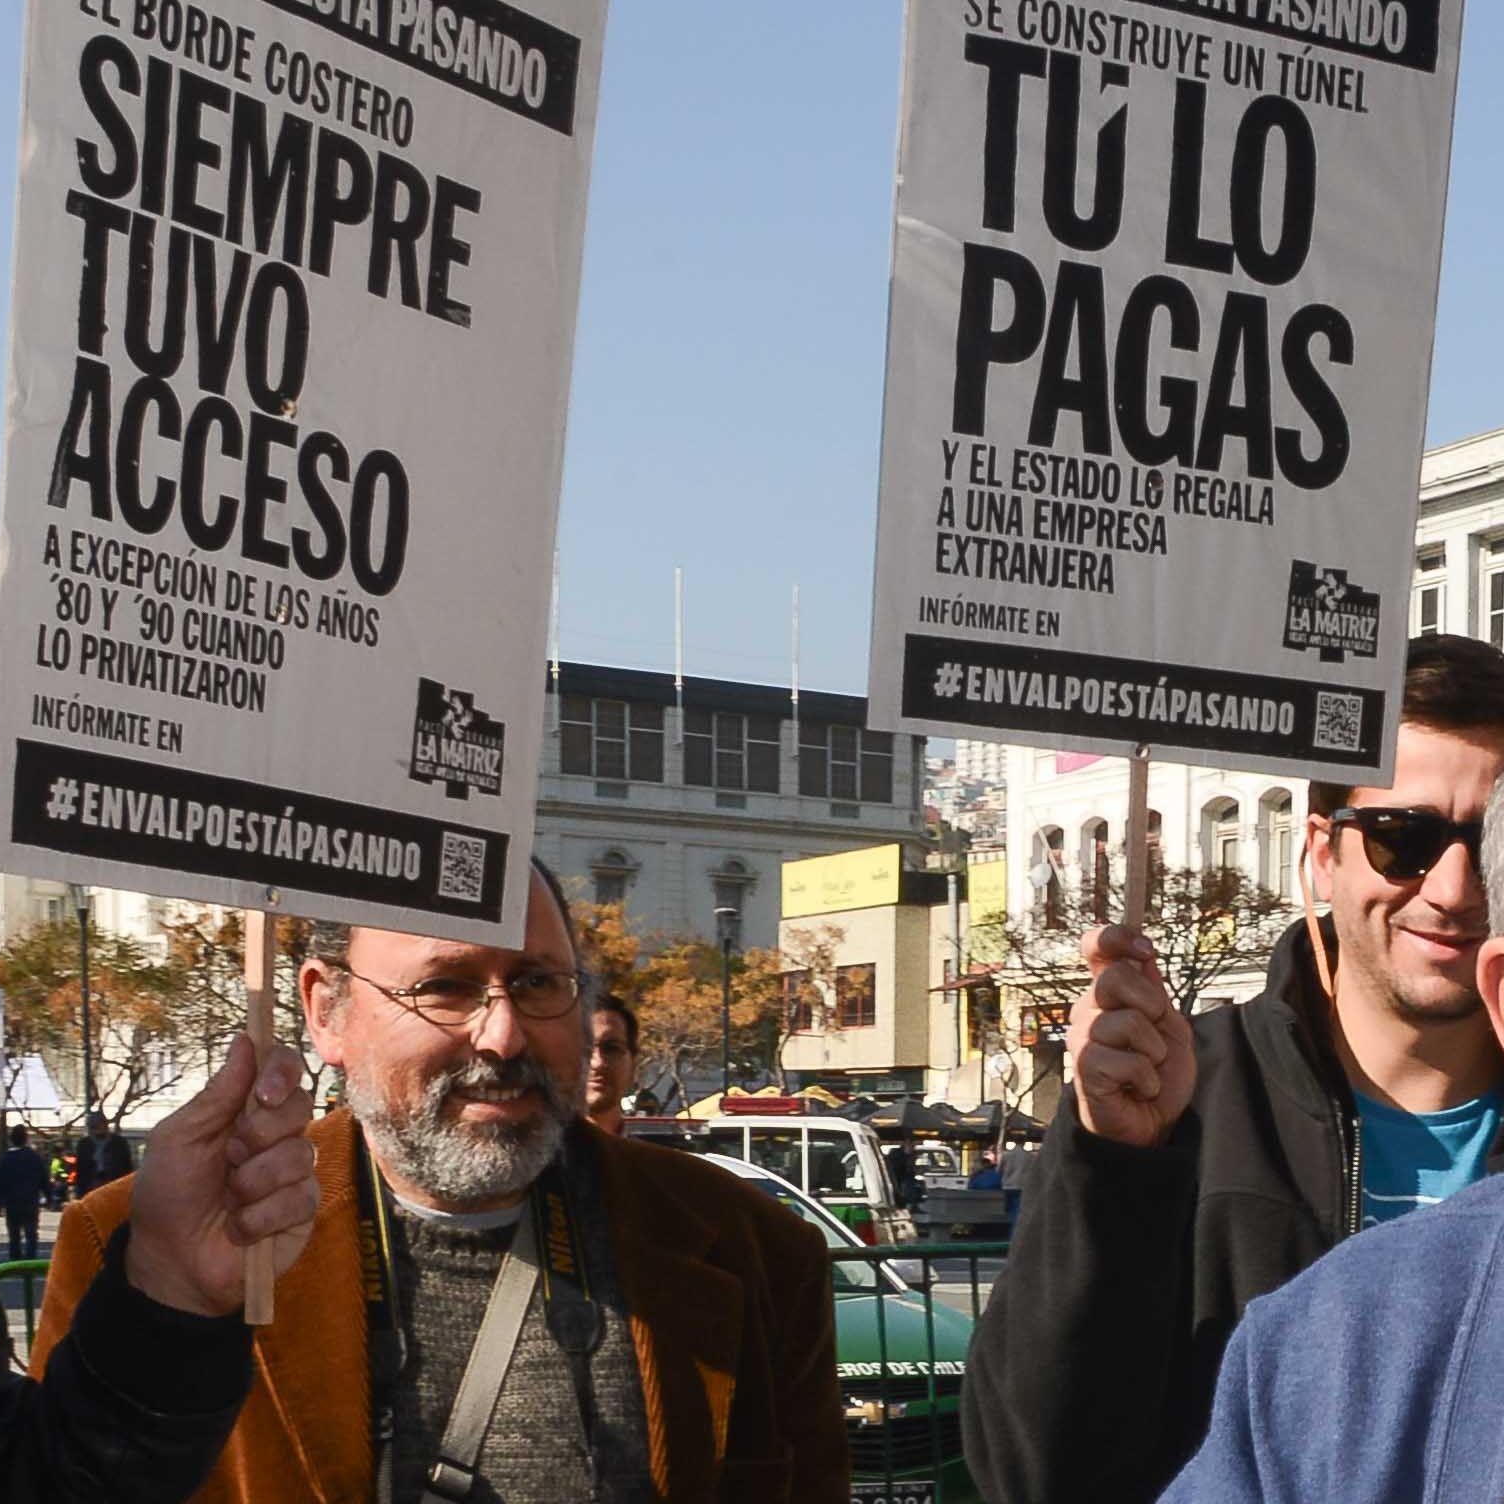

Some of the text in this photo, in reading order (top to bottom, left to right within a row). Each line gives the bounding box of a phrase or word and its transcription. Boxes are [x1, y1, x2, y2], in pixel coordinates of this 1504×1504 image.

[132, 0, 256, 85] BORDE
[264, 41, 415, 149] COSTERO
[389, 0, 549, 110] PASANDO
[964, 0, 1369, 114] SE CONSTRUYE UN TÚNEL
[75, 34, 482, 329] SIEMPRE
[963, 33, 1318, 287] TÚ LO
[64, 189, 311, 418] TUVO
[951, 241, 1355, 491] PAGAS
[47, 355, 410, 597] ACCESO
[936, 486, 1168, 555] A UNA EMPRESA
[942, 440, 1275, 526] Y EL ESTADO LO REGALA
[43, 524, 380, 648] A EXCEPCIÓN DE LOS AÑOS
[919, 594, 1061, 638] INFÓRMATE EN
[934, 532, 1115, 595] EXTRANJERA
[36, 623, 267, 713] LO PRIVATIZARON
[100, 586, 121, 633] Y
[181, 605, 287, 671] CUANDO
[1314, 610, 1377, 641] MATRIZ
[31, 692, 184, 755] INFÓRMATE EN
[933, 660, 1296, 736] #ENVALPOESTÁPASANDO
[45, 775, 423, 882] #ENVALPOESTÁPASANDO
